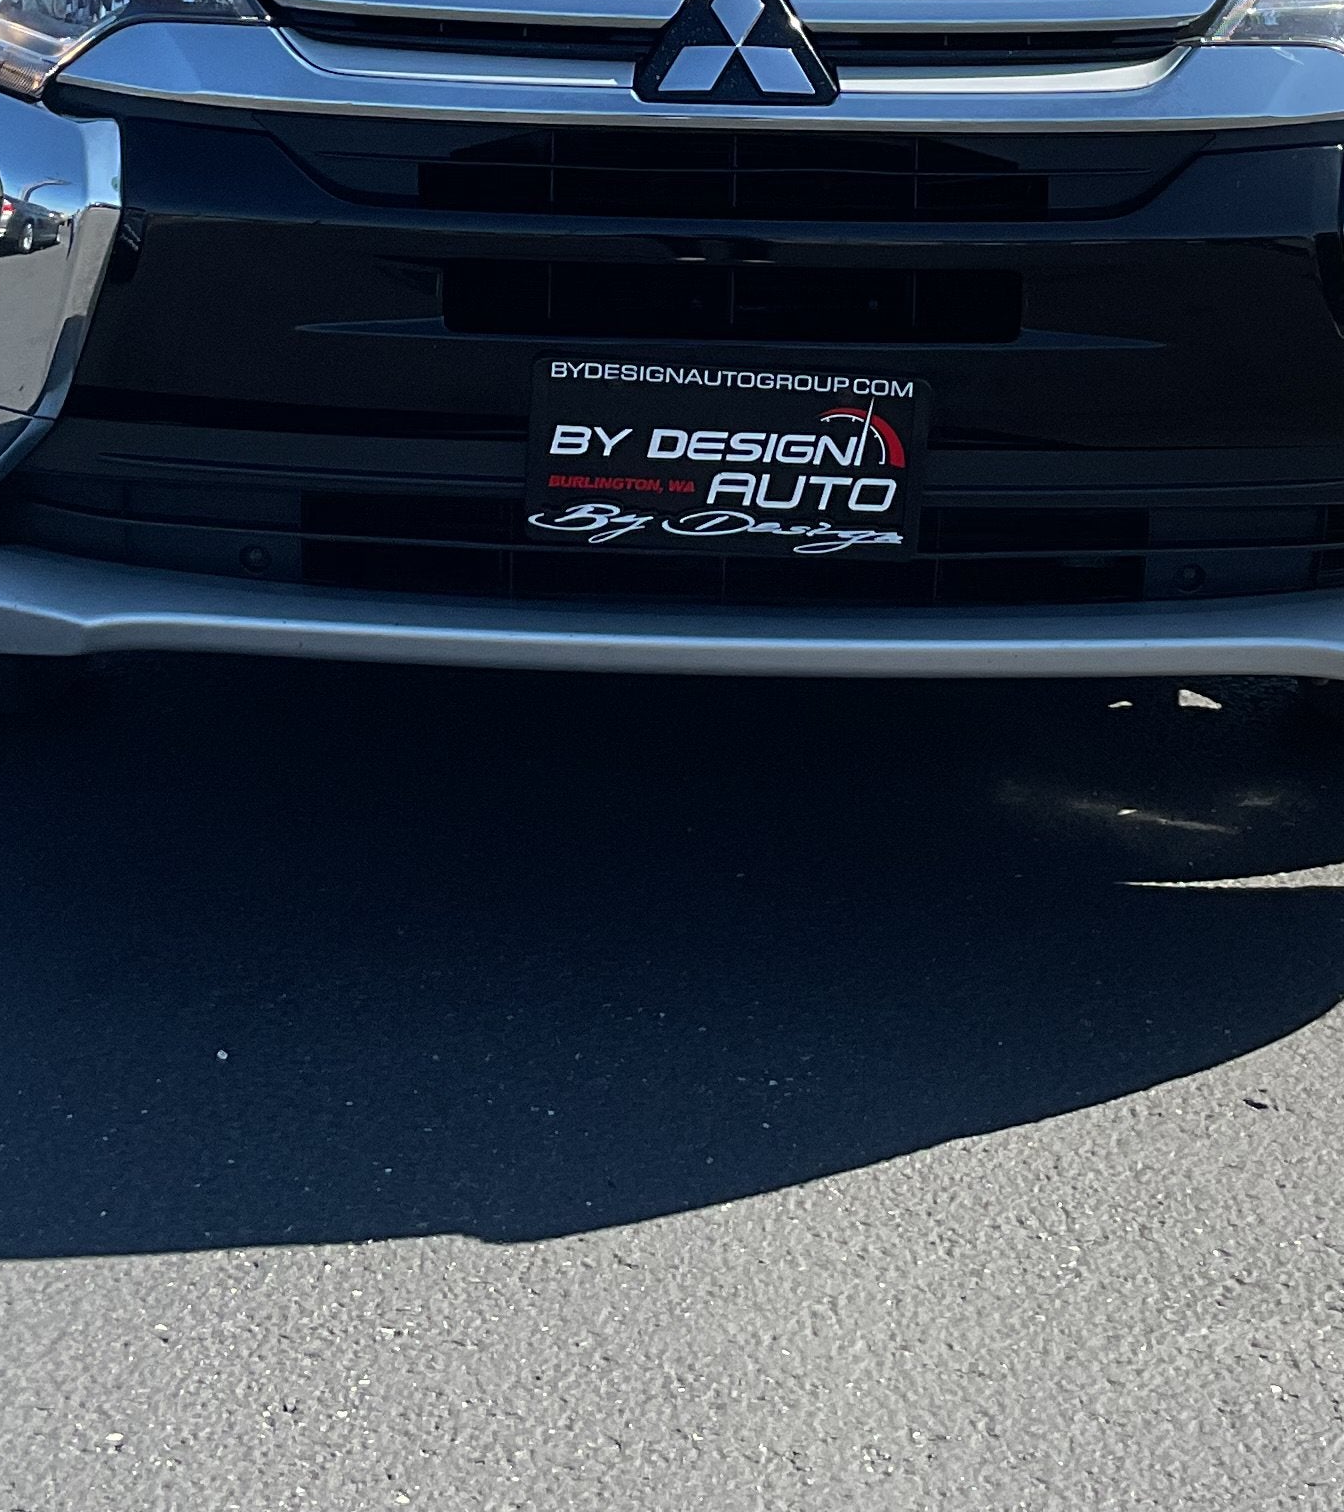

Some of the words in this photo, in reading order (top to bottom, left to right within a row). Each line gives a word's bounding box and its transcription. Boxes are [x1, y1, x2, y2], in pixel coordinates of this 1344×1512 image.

[550, 361, 914, 398] BYDESIGNAUTOGROUPCOM
[549, 425, 634, 456] BY
[646, 428, 860, 466] DESIGN
[548, 474, 664, 494] BURLINGTON,
[668, 479, 696, 493] WA
[706, 471, 898, 512] AUTO
[528, 503, 654, 544] By
